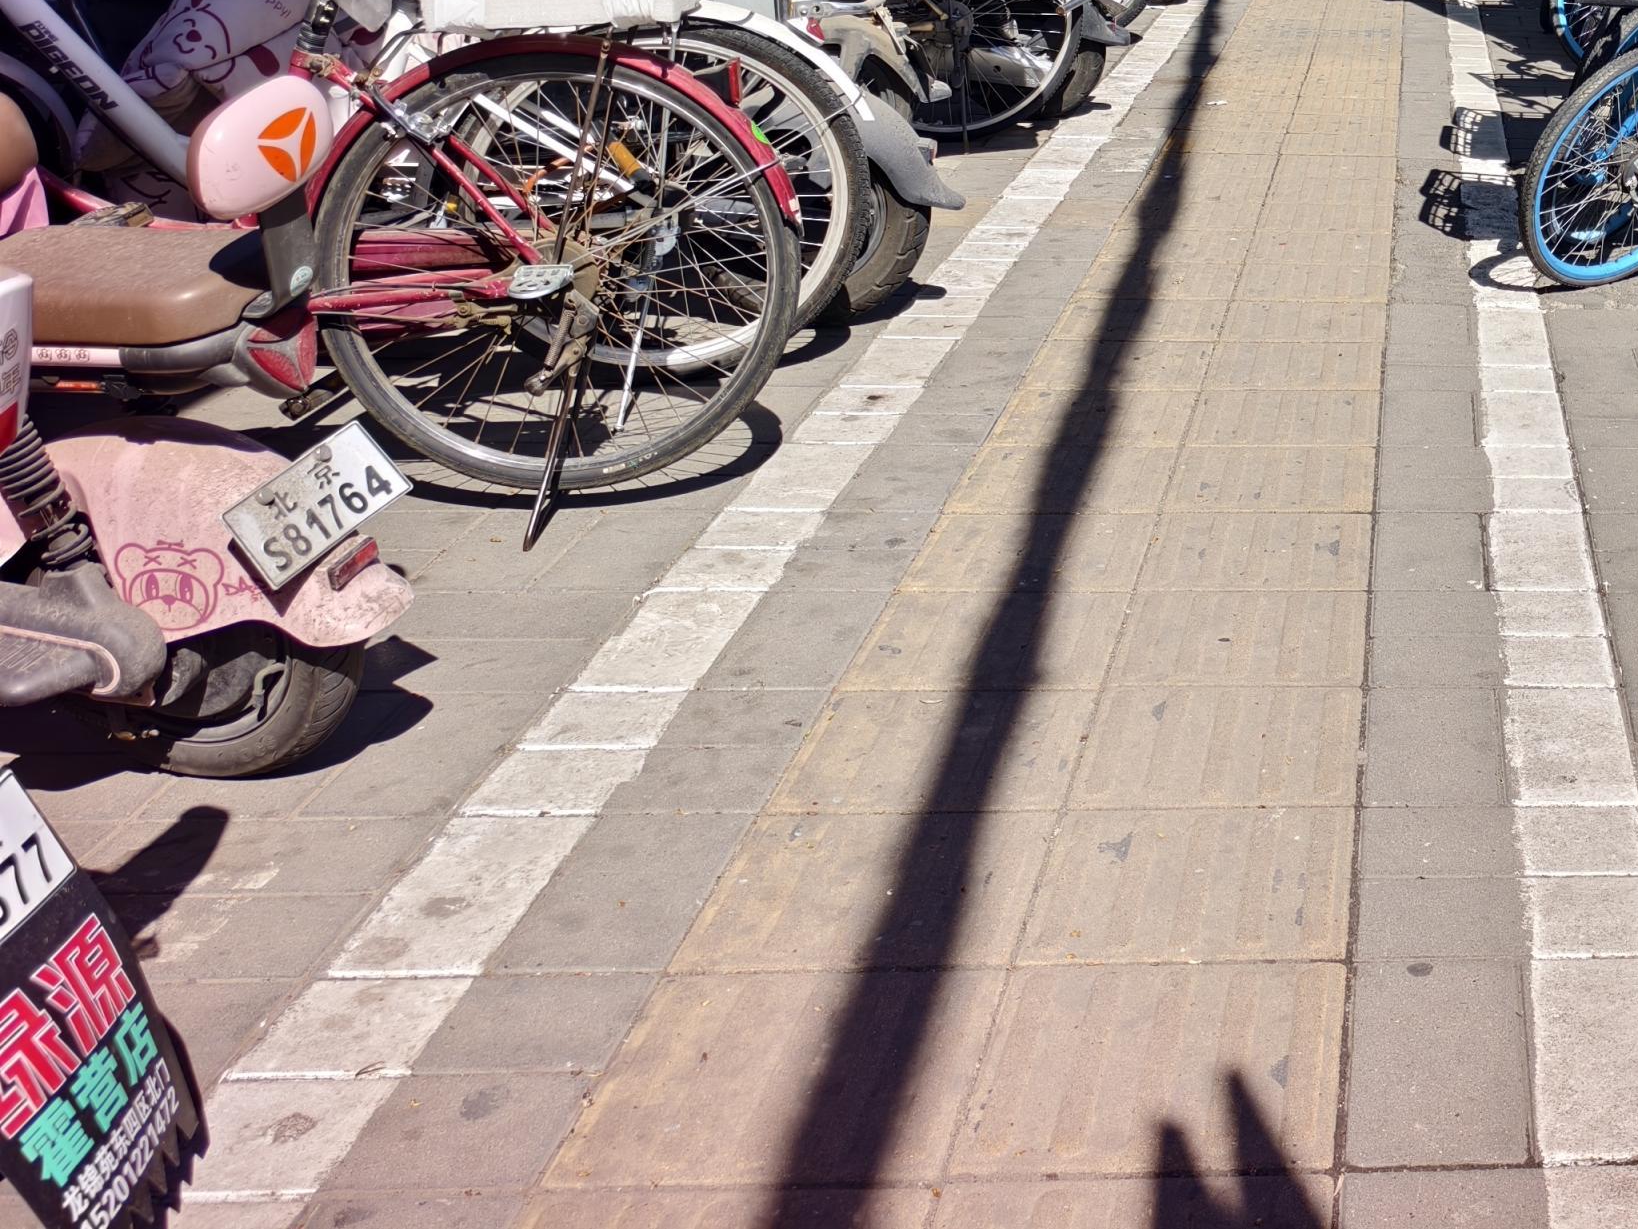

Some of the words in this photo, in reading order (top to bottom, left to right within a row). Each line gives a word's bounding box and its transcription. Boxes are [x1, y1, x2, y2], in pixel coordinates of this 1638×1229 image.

[263, 465, 393, 572] S81764
[268, 462, 341, 520] 北京
[0, 831, 54, 924] 77
[19, 1002, 159, 1189] 霍营店
[62, 1057, 171, 1222] 龙锦苑东四区北门
